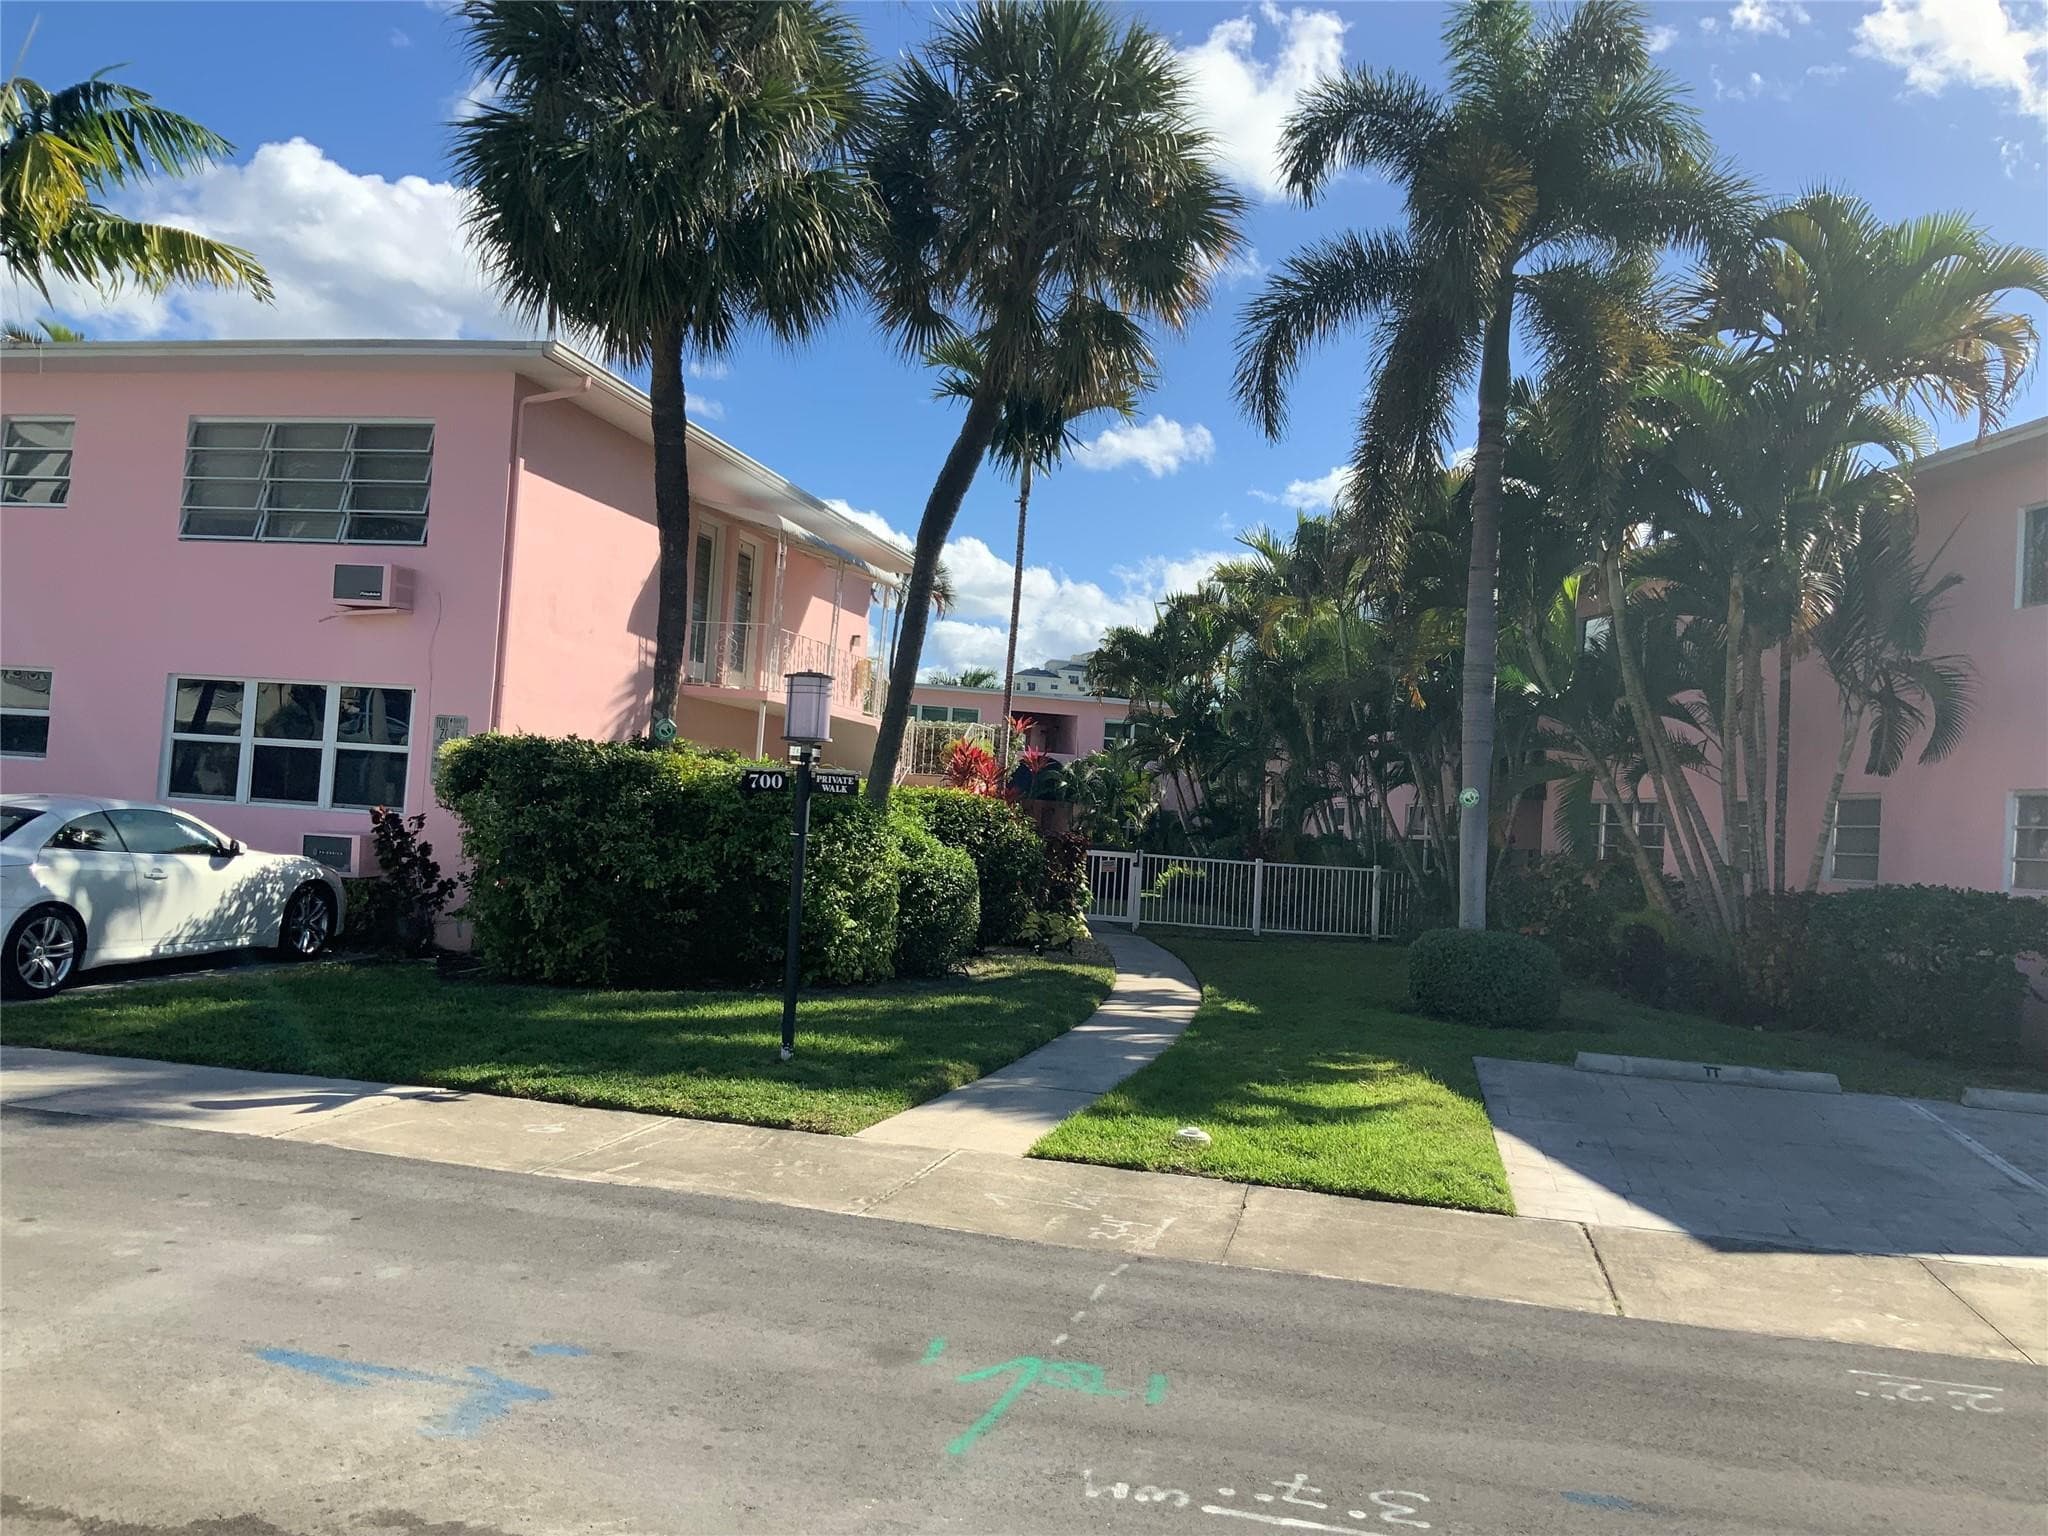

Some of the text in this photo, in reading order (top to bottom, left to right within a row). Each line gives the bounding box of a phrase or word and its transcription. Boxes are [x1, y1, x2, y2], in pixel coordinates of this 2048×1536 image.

[748, 774, 783, 789] 700
[816, 775, 855, 785] PRIVATE
[821, 783, 848, 794] WALK
